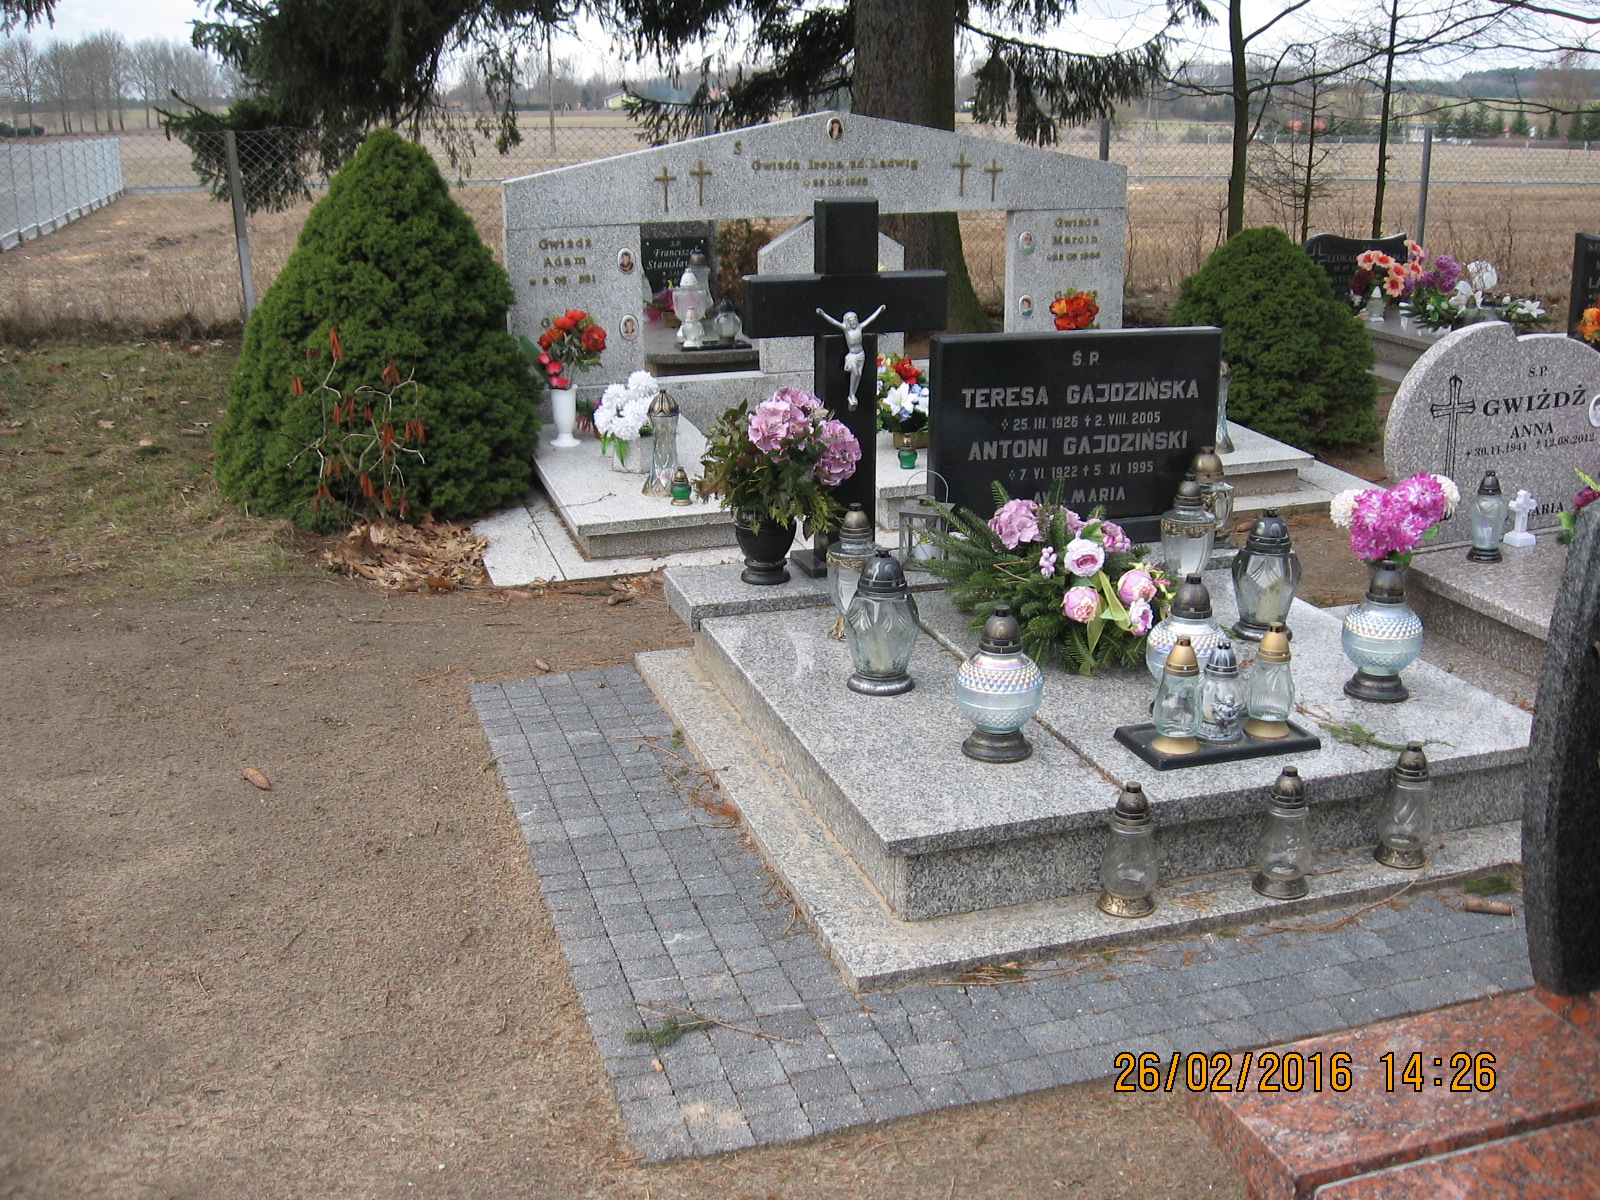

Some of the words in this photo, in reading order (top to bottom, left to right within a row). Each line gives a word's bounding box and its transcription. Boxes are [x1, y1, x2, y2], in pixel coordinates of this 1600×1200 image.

[543, 256, 587, 267] Adam
[654, 248, 696, 258] Francisze
[961, 387, 1049, 408] TERESA
[1066, 377, 1199, 405] GAJDZIŃSKA
[1482, 384, 1587, 417] GWIŻDŻ
[1052, 416, 1079, 429] 1926
[1131, 411, 1161, 425] 2005
[1510, 421, 1555, 439] ANNA
[968, 438, 1048, 461] ANTONI
[1063, 428, 1188, 456] GAJDZIŃSKI
[1475, 441, 1527, 457] 30.11.1941
[1544, 432, 1596, 448] 12.08.2012
[1052, 465, 1079, 479] 1922
[1128, 461, 1154, 474] 1995
[1070, 486, 1126, 504] MARIA
